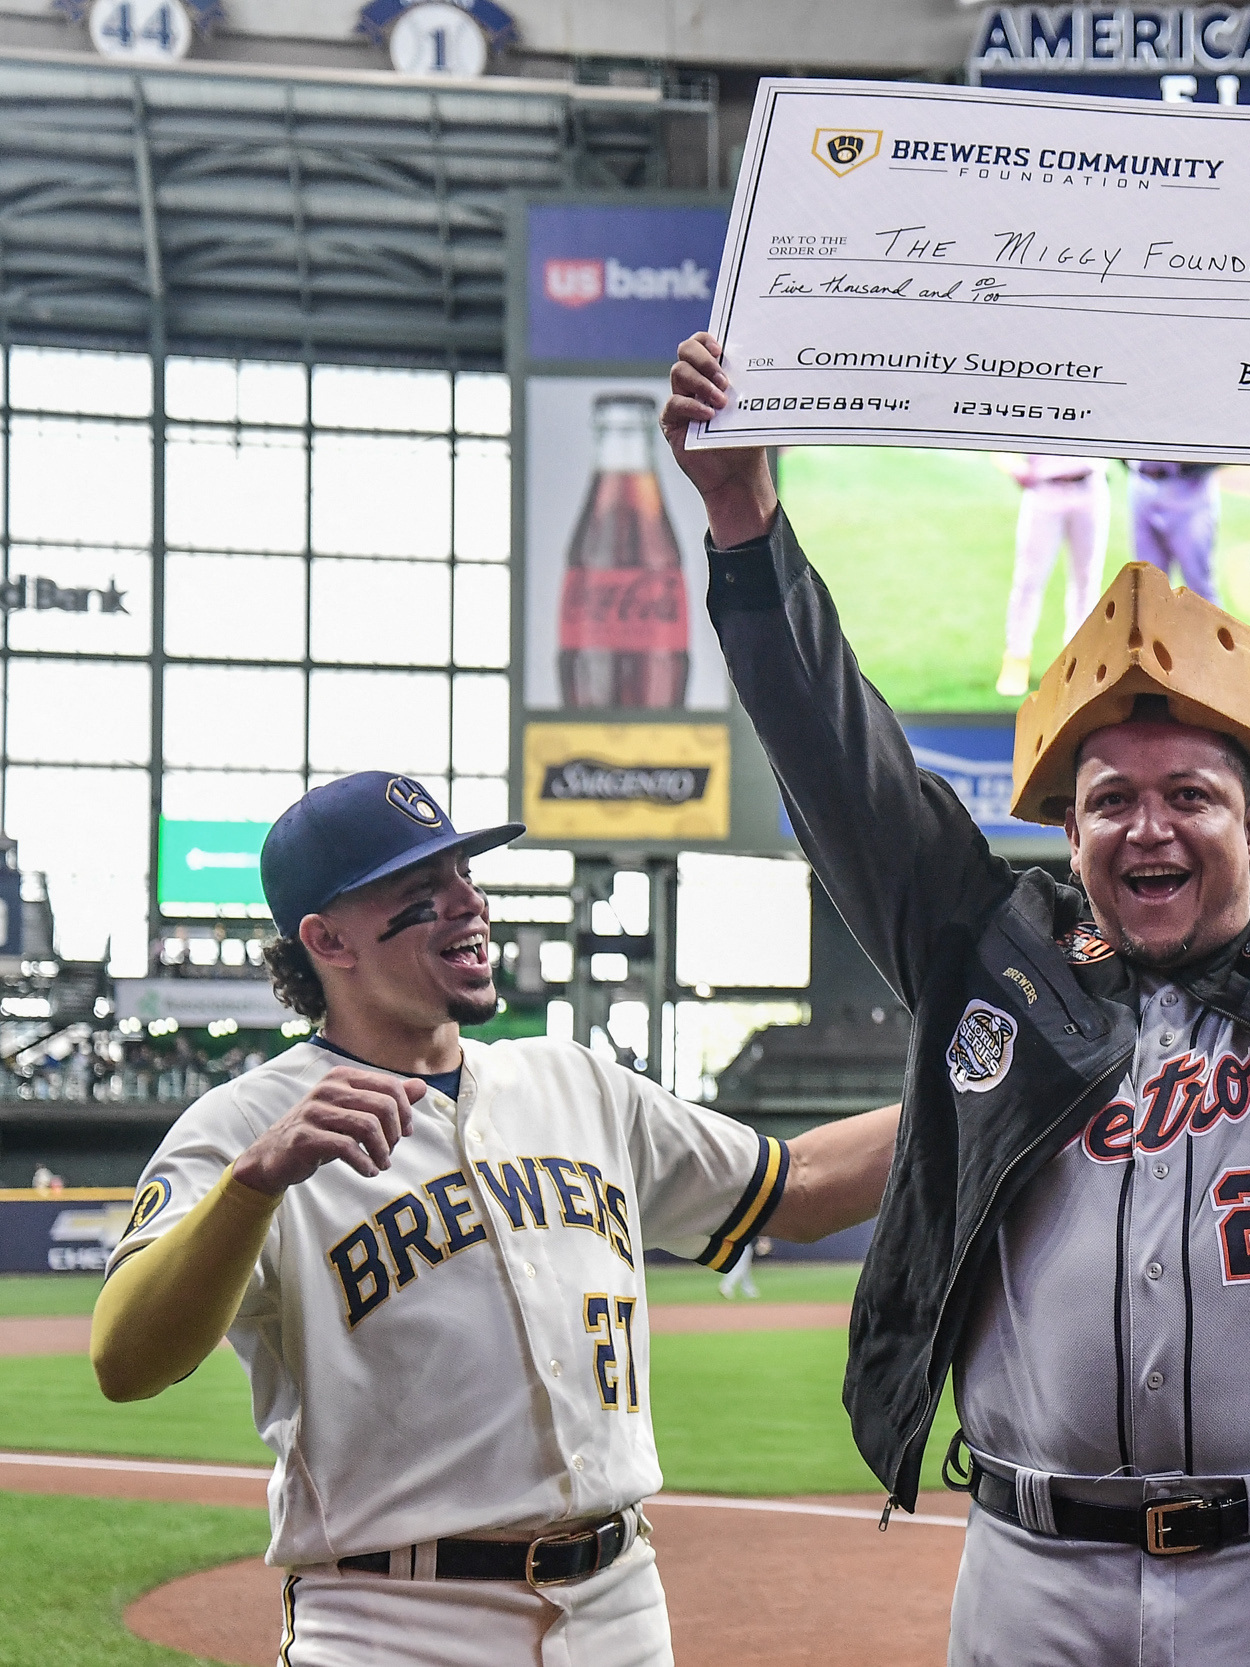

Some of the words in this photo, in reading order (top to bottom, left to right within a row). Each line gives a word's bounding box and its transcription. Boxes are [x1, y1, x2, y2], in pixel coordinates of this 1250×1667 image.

[102, 2, 178, 50] 44
[427, 28, 447, 72] 1
[891, 139, 1031, 167] BREWERS
[1038, 149, 1225, 180] COMMUNITY
[959, 167, 1150, 190] FOUNDATION
[768, 246, 814, 256] ORDER
[817, 246, 838, 256] OF
[770, 235, 795, 246] PAY
[797, 235, 817, 246] TO
[820, 235, 848, 246] THE
[875, 225, 957, 259] THE
[994, 231, 1122, 284] MIGGY
[545, 263, 599, 300] us
[604, 256, 713, 301] bank
[768, 272, 813, 295] Five
[819, 273, 914, 298] thousand
[918, 280, 964, 300] and
[747, 357, 775, 368] FOR
[796, 346, 958, 375] Community
[962, 352, 1104, 379] Supporter
[1002, 966, 1039, 1006] BREWERS
[959, 1019, 1001, 1076] SERIES
[966, 1014, 1002, 1059] WORLD
[326, 1155, 636, 1334] BREWERS
[582, 1291, 640, 1414] 27
